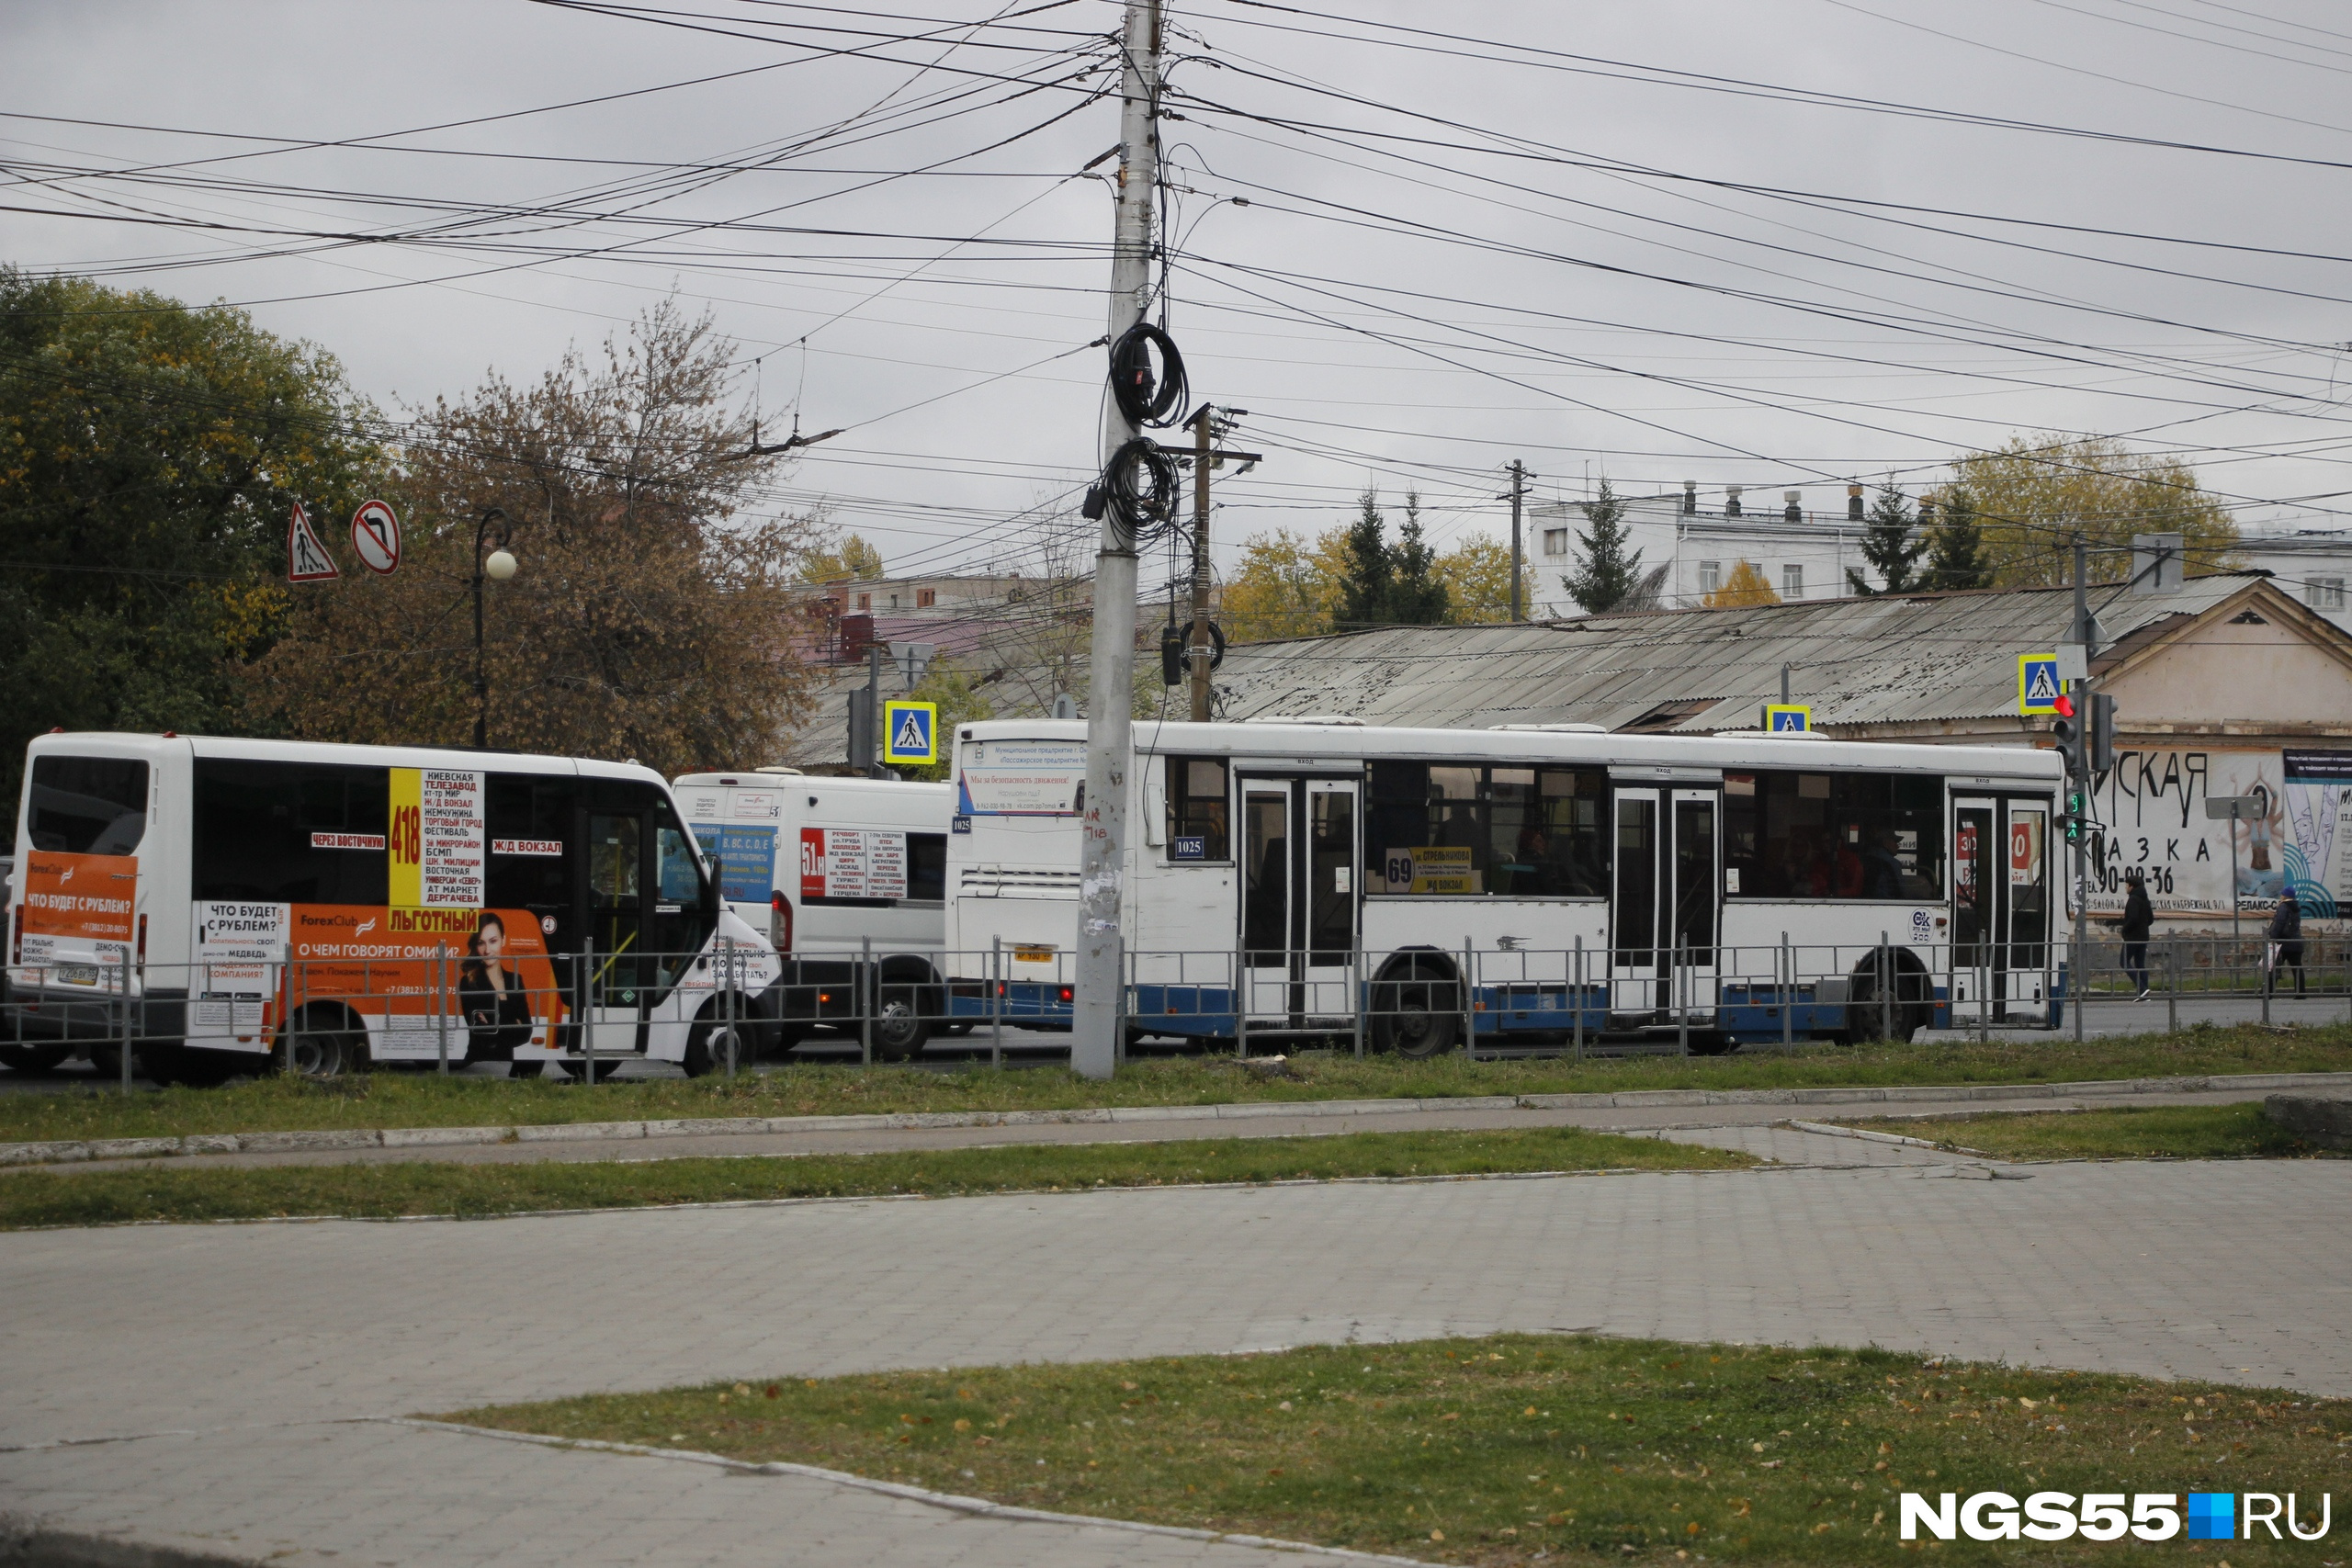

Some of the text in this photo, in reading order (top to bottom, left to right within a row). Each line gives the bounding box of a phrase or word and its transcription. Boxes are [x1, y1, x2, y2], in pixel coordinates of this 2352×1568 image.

[995, 746, 1037, 754] Муниципальное
[1038, 747, 1074, 755] предприятие
[427, 773, 474, 781] КИЕВСКАЯ
[990, 776, 1033, 784] безопасность
[1034, 776, 1069, 784] движения!
[425, 781, 477, 792] ТЕЛЕЗАВОД
[424, 798, 473, 808] Ж/Д ВОКЗАЛ
[424, 808, 473, 818] ЖЕМЧУЖИНА
[424, 817, 483, 829] ТОРГОВЫЙ ГОРОД
[954, 820, 970, 831] 1025
[391, 805, 421, 864] 418
[424, 827, 469, 837] ФЕСТИВАЛЬ
[312, 834, 385, 848] ЧЕРЕЗ ВОСТОЧНУЮ
[425, 839, 481, 849] 5й МИКРОРАЙОН
[493, 840, 562, 853] Ж/Д ВОКЗАЛ
[1177, 840, 1202, 853] 1025
[425, 847, 452, 857] БСМП
[1423, 851, 1470, 862] СТРЕЛЬНИКОВА
[425, 858, 481, 867] ШК. МИЛИЦИИ
[425, 866, 470, 875] ВОСТОЧНАЯ
[1387, 857, 1412, 884] 69
[425, 875, 481, 885] УНИВЕРСАМ «СЕВЕР»
[1439, 879, 1464, 890] ВОКЗАЛ
[427, 885, 480, 894] АТ МАРКЕТ
[28, 893, 131, 914] ЧТО БУДЕТ С РУБЛЕМ?
[427, 894, 480, 903] ДЕРГАЧЕВА
[211, 905, 277, 919] ЧТО БУДЕТ
[208, 919, 277, 931] С РУБЛЕМ?
[300, 914, 359, 927] ForexClub
[390, 908, 477, 931] ЛЬГОТНЫЙ
[228, 950, 267, 959] МЕДВЕДЬ
[299, 944, 310, 955] О
[312, 944, 340, 956] ЧЕМ
[343, 944, 402, 958] ГОВОРЯТ
[397, 986, 424, 995] (3812)
